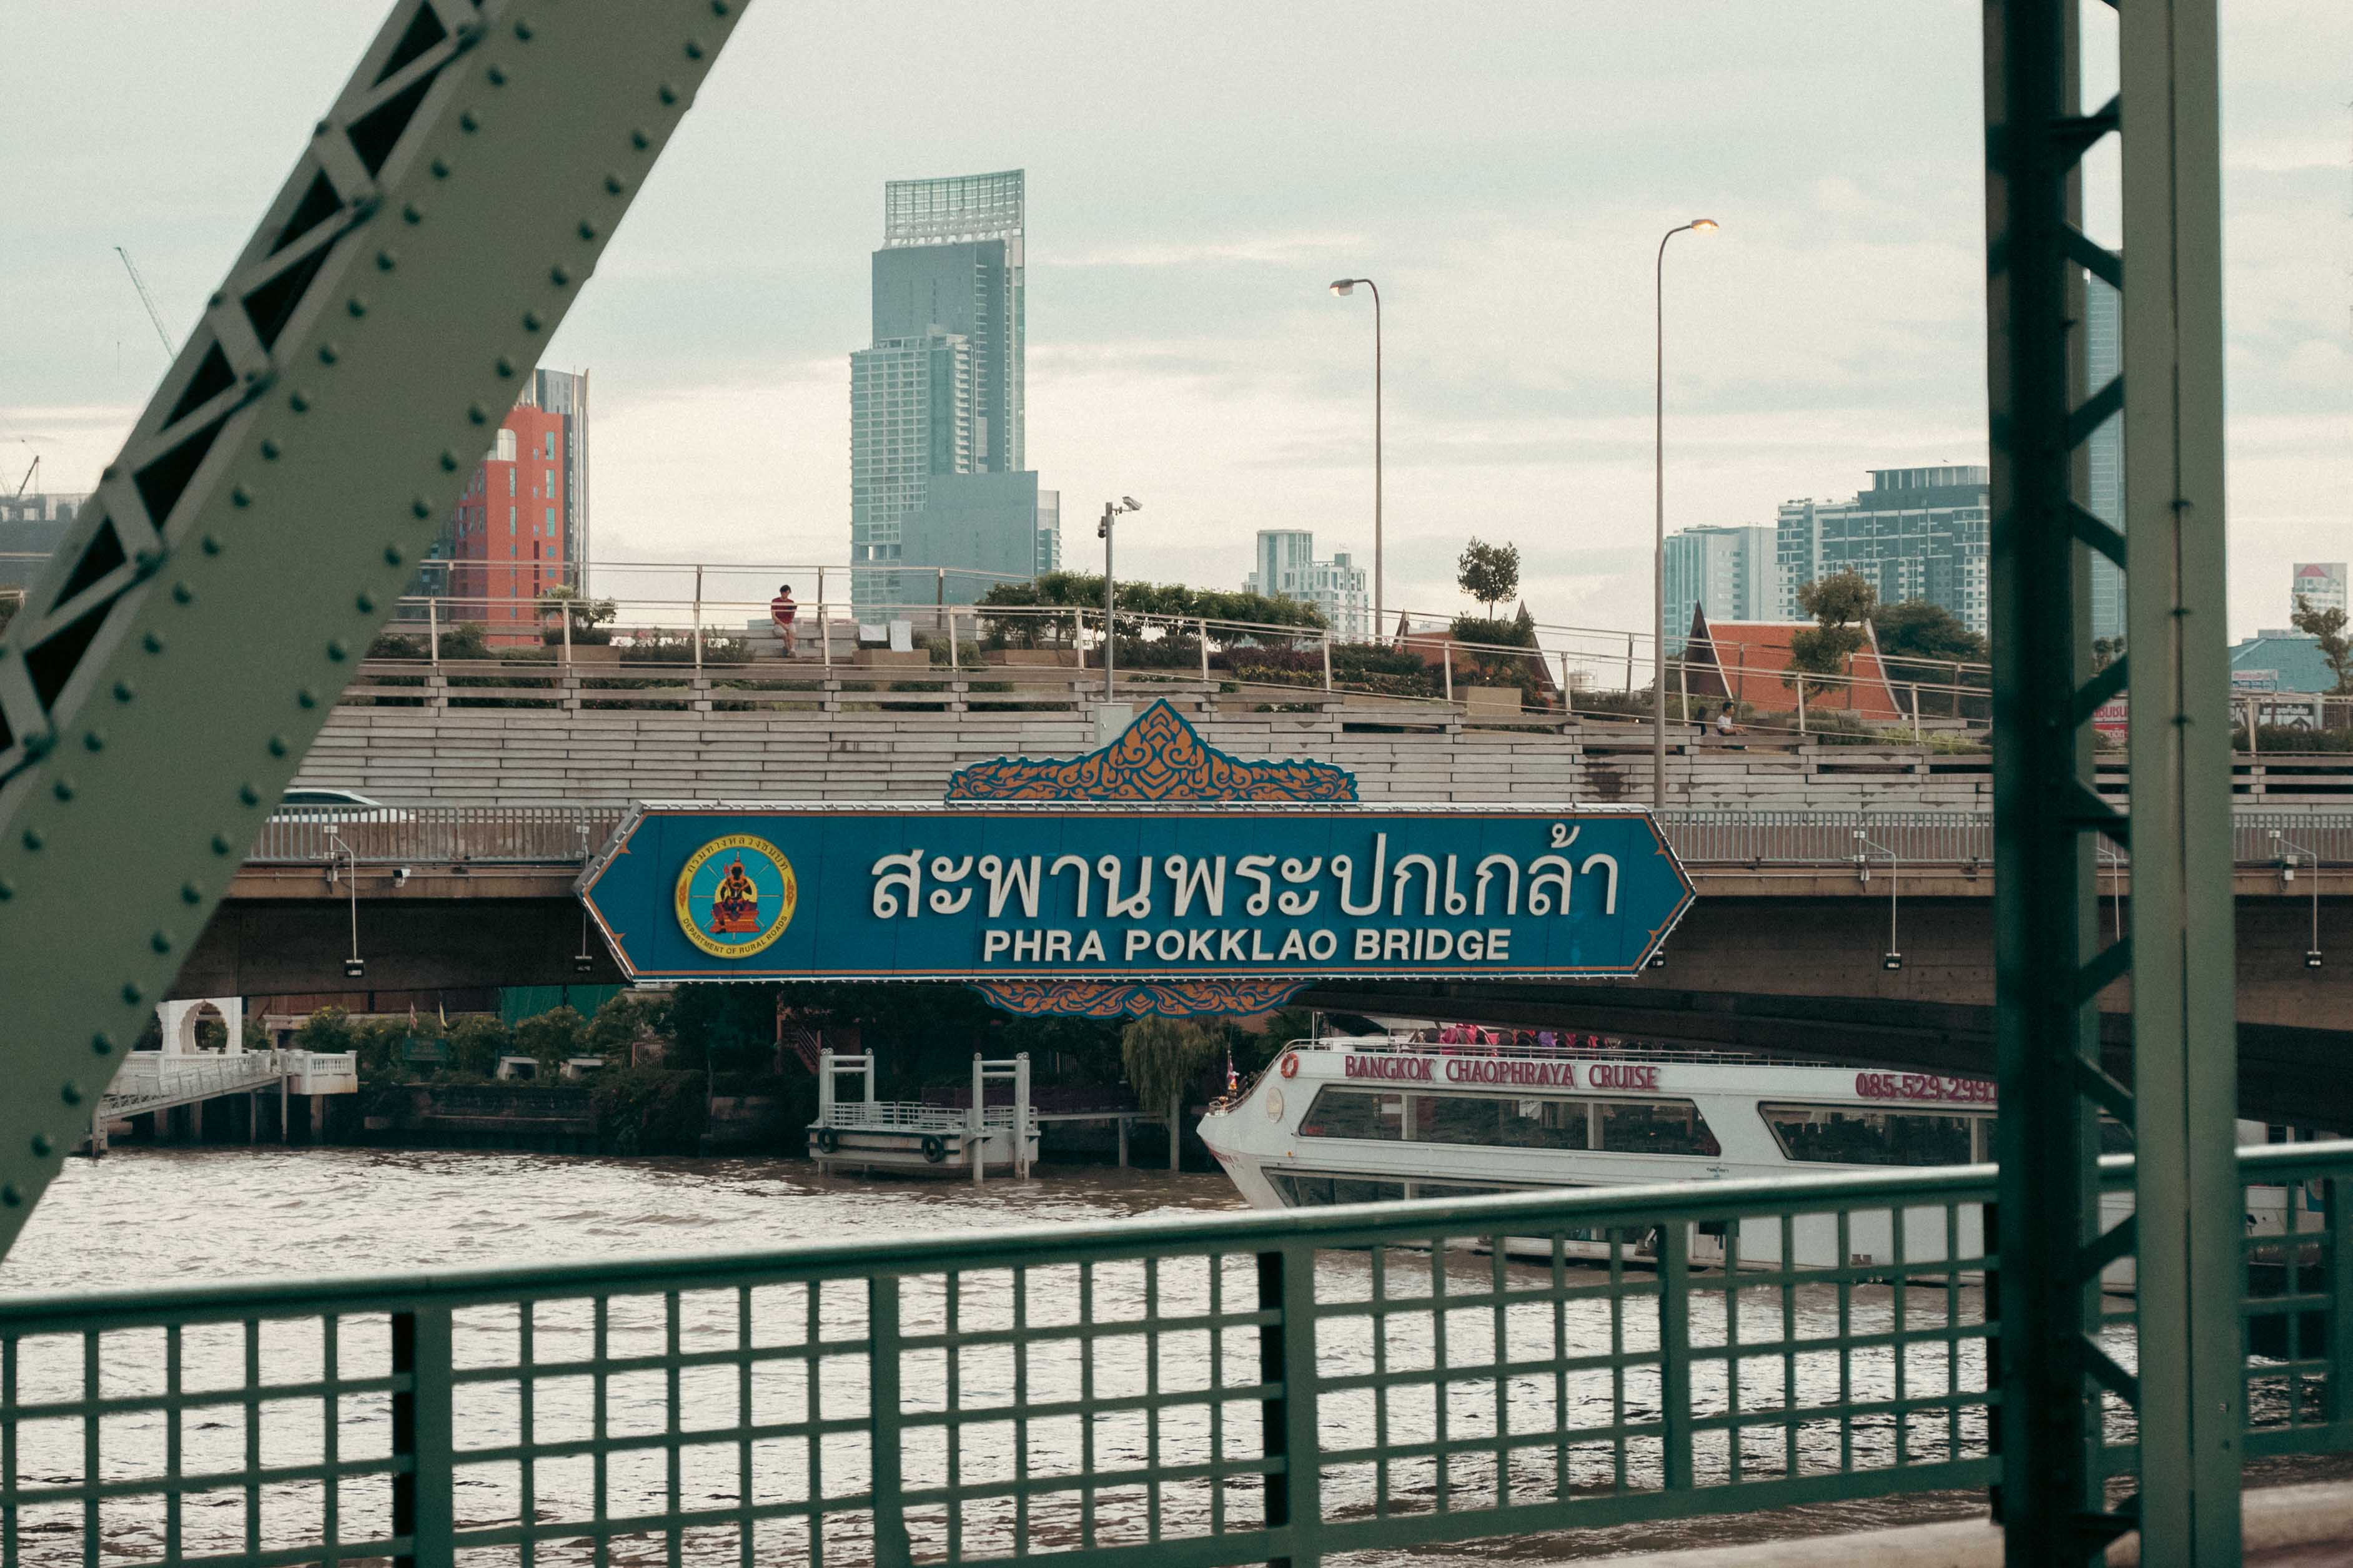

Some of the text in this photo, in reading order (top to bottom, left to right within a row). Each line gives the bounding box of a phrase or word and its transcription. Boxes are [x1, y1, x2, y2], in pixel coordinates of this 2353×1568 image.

[688, 836, 789, 874] กรมทางหลวงชนบท
[872, 823, 1618, 919] สะพานพระปกเกล้า
[683, 917, 724, 954] DEPARTMENT
[739, 940, 766, 954] RURAL
[766, 915, 788, 940] ROADS
[984, 929, 1511, 962] PHRA POKKLAO BRIDGE
[1345, 1055, 1658, 1090] BANGKOK CHAOPHRAYA CRUISE
